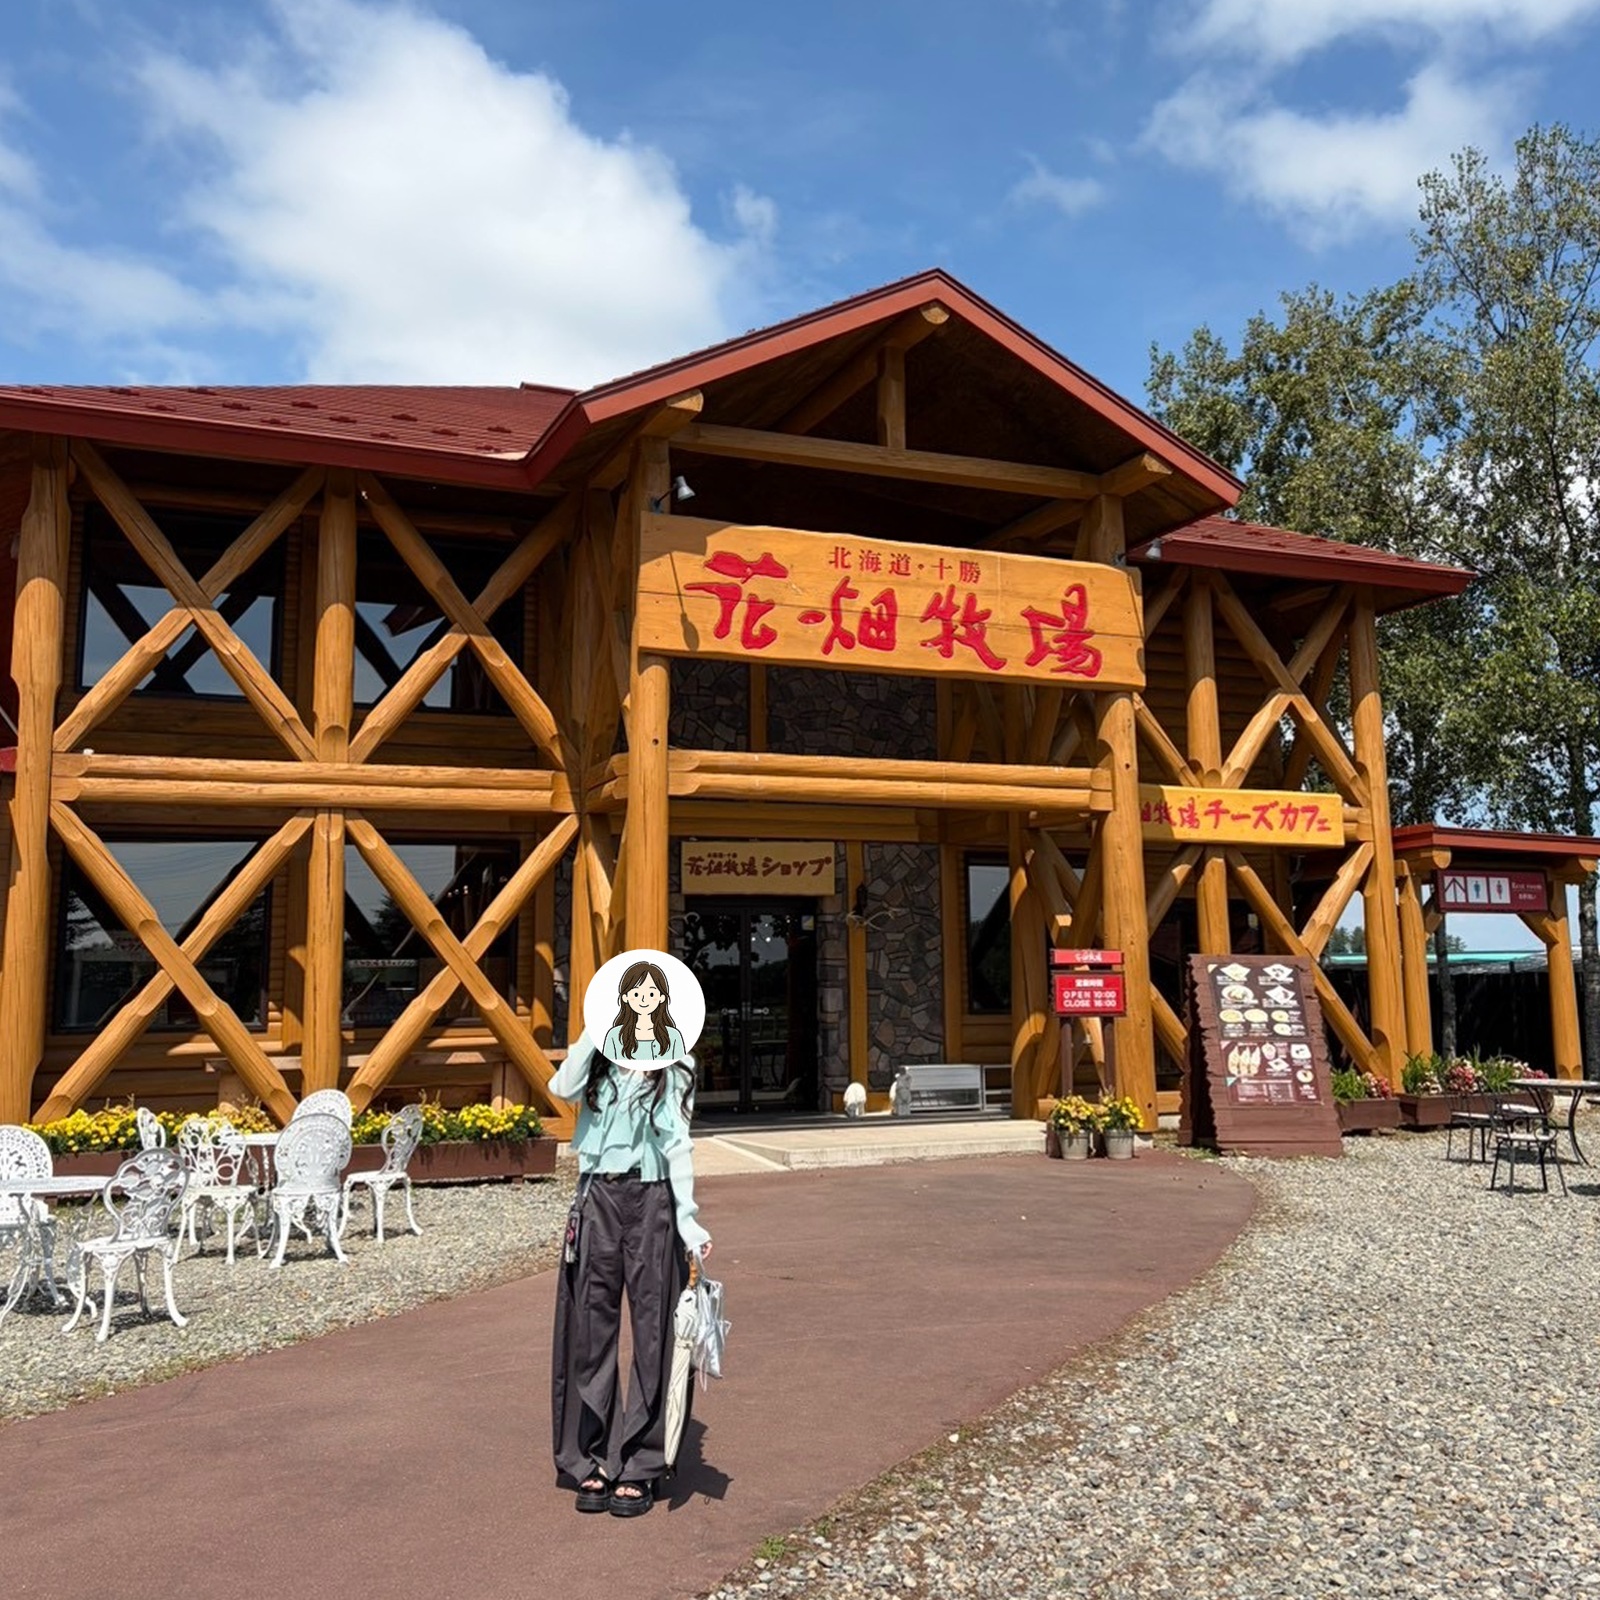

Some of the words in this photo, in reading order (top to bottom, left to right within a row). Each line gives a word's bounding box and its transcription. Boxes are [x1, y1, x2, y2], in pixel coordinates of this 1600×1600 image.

[829, 545, 981, 584] 北海道・十勝
[684, 550, 1103, 678] 花畑牧場
[1063, 990, 1091, 999] OPEN
[1063, 999, 1091, 1008] CLOSE
